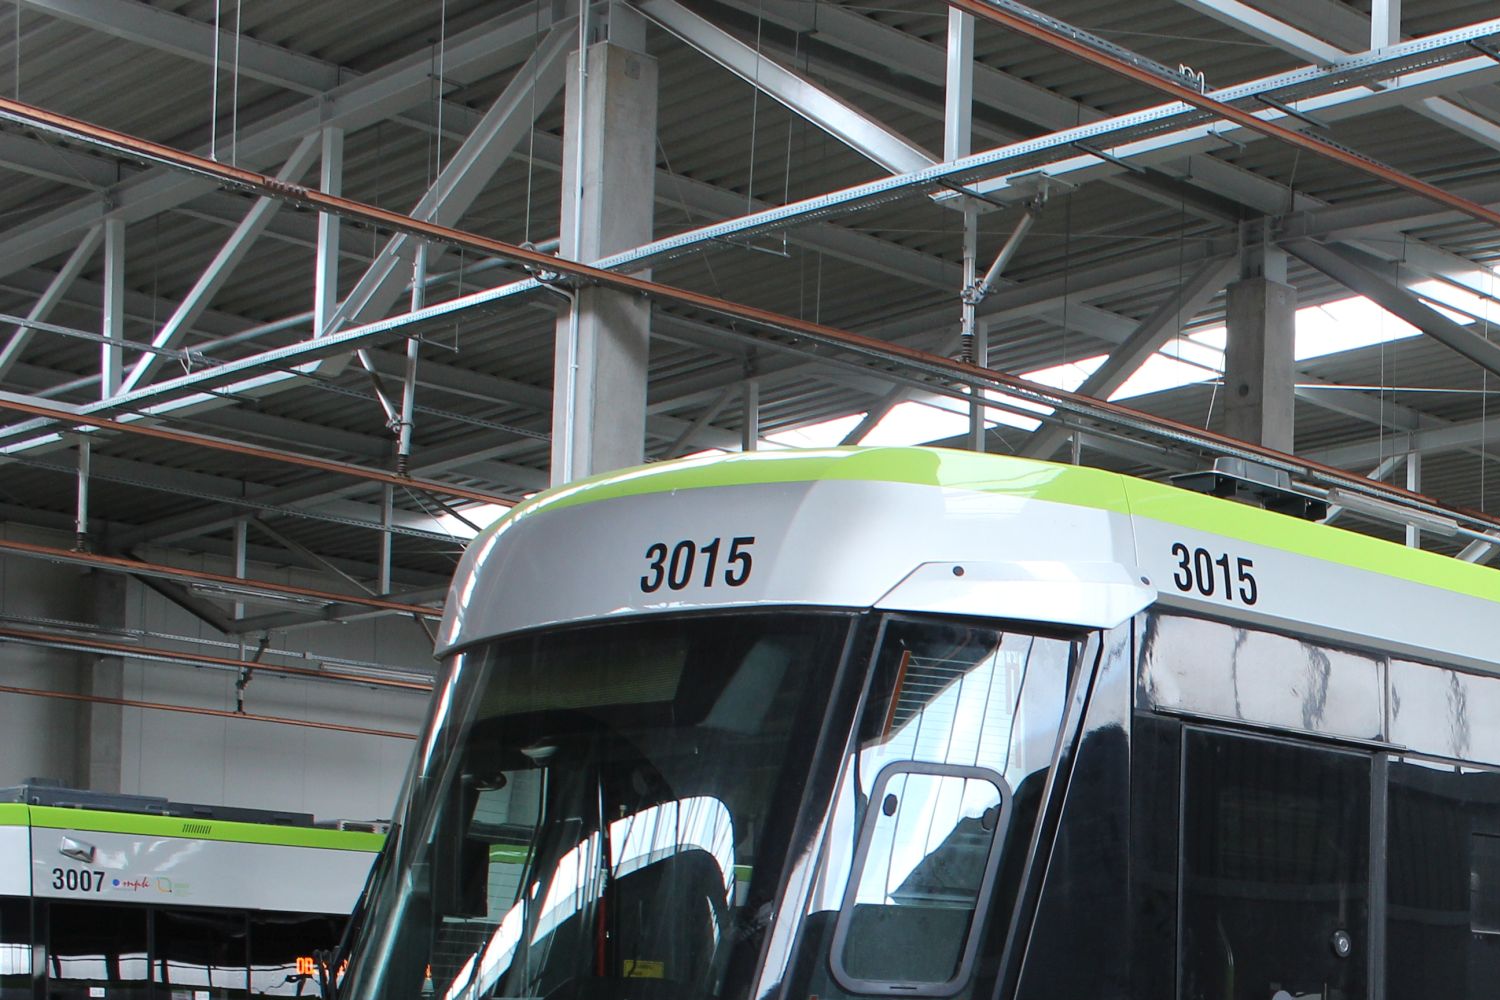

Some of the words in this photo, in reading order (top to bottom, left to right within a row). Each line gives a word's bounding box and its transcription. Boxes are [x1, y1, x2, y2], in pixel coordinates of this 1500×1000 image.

[640, 537, 755, 593] 3015
[1171, 542, 1257, 606] 3015
[52, 868, 105, 892] 3007
